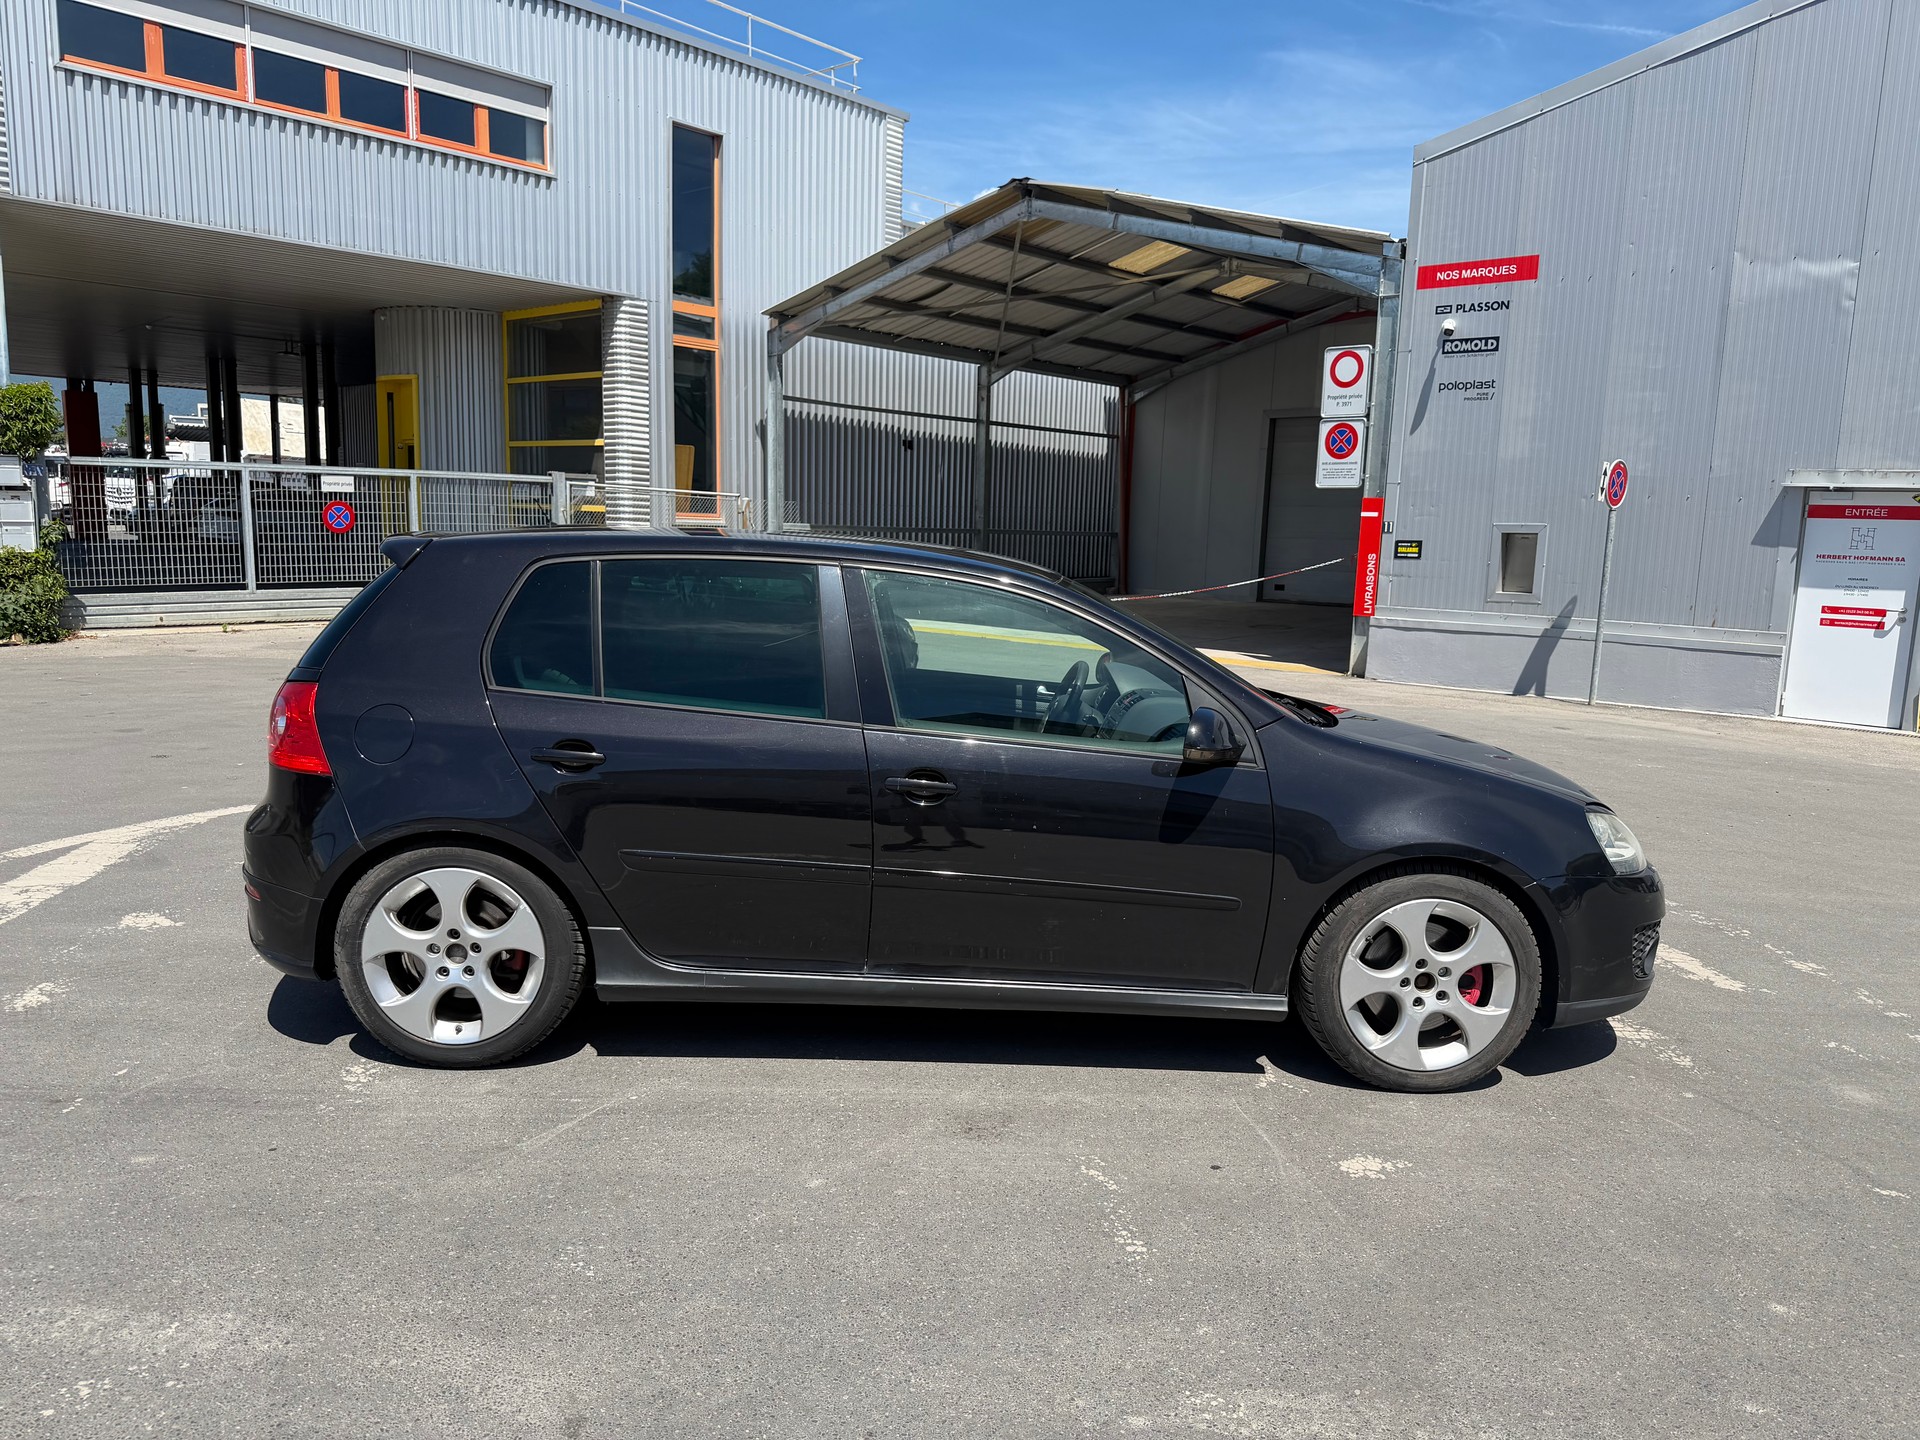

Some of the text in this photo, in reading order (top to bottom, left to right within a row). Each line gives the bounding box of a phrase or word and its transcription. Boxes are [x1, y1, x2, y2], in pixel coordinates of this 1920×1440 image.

[1436, 264, 1517, 281] NOS MARQUES
[1455, 300, 1510, 314] PLASSON
[1443, 339, 1497, 353] ROMOLD
[1438, 379, 1496, 393] poloplast
[1845, 507, 1889, 517] ENTRÉE
[1384, 521, 1393, 533] 11
[1816, 553, 1853, 561] HERBERT
[1363, 553, 1377, 614] LIVRAISONS
